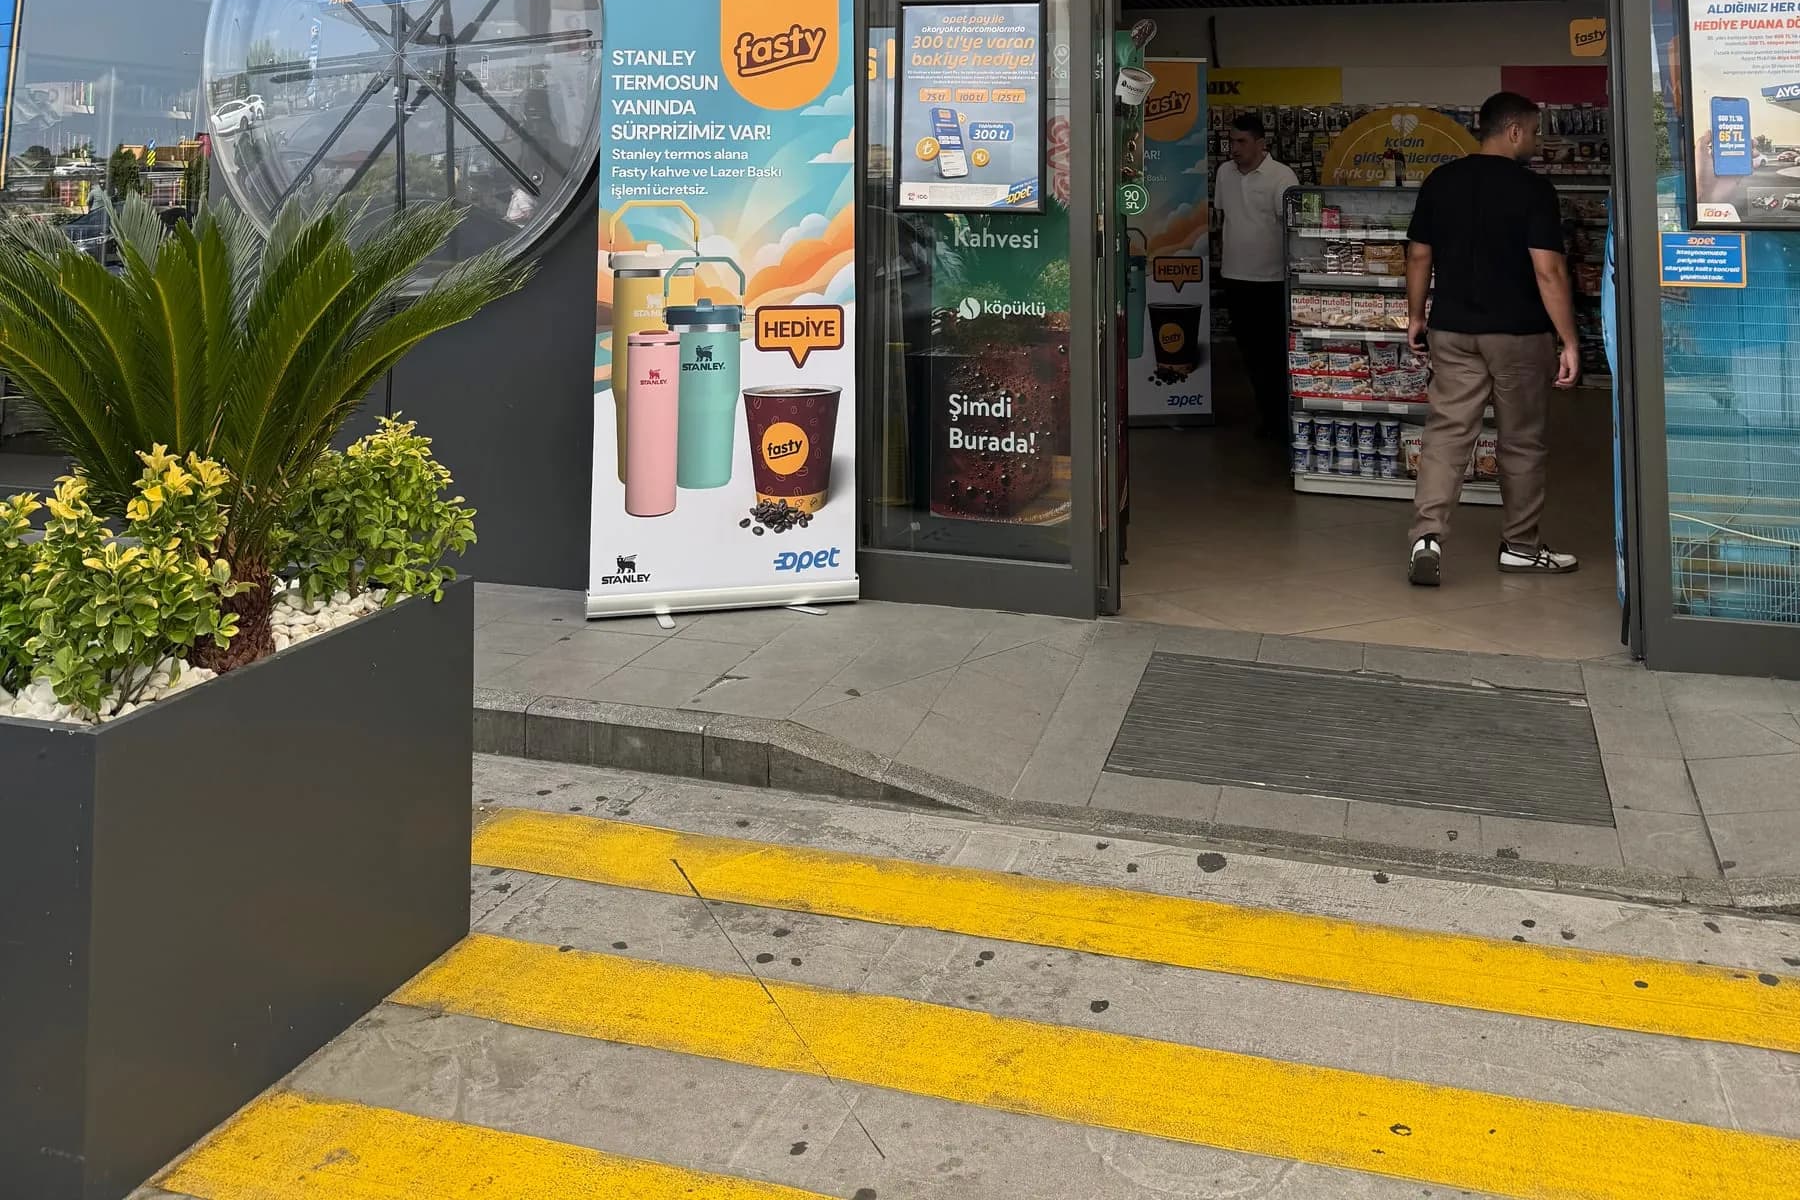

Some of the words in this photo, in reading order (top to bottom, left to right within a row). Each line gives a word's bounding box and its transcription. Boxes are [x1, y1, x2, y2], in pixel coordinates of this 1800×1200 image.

[1707, 1, 1768, 14] ALDIĞINIZ
[1770, 2, 1795, 13] HER
[1694, 18, 1738, 31] HEDİYE
[1740, 19, 1784, 30] PUANA
[912, 36, 944, 49] 300
[945, 36, 983, 52] tl'ye
[986, 37, 1035, 49] varan
[1575, 30, 1606, 46] fasty
[612, 50, 696, 66] STANLEY
[734, 24, 826, 77] fasty
[911, 53, 968, 70] bakiye
[971, 52, 1036, 70] hediye!
[612, 75, 718, 91] TERMOSUN
[611, 100, 696, 115] YANINDA
[611, 121, 725, 140] SÜRPRİZİMİZ
[729, 124, 771, 140] VAR!
[973, 129, 997, 140] 300
[999, 129, 1010, 140] tl
[1732, 132, 1745, 141] TL
[612, 148, 661, 163] Stanley
[664, 149, 711, 160] termos
[714, 149, 748, 160] alana
[612, 166, 648, 181] Fasty
[650, 166, 690, 178] kahve
[692, 168, 707, 178] ve
[710, 166, 745, 178] Lazer
[747, 166, 782, 178] Baskı
[611, 184, 651, 200] işlemi
[653, 184, 709, 196] ücretsiz.
[1006, 185, 1034, 204] opet
[1124, 191, 1139, 202] 90
[954, 227, 1039, 249] Kahvesi
[1688, 237, 1716, 246] opet
[1157, 259, 1199, 276] HEDİYE
[984, 299, 1046, 319] köpüklü
[1322, 299, 1350, 307] nutella
[1354, 300, 1383, 308] nutella
[764, 316, 835, 338] HEDİYE
[682, 362, 725, 372] STANLEY
[949, 394, 1012, 422] Şimdi
[1167, 393, 1204, 408] opet
[767, 438, 803, 460] fasty
[949, 428, 1036, 454] Burada!
[773, 547, 840, 571] opet
[601, 573, 651, 585] STANLEY
